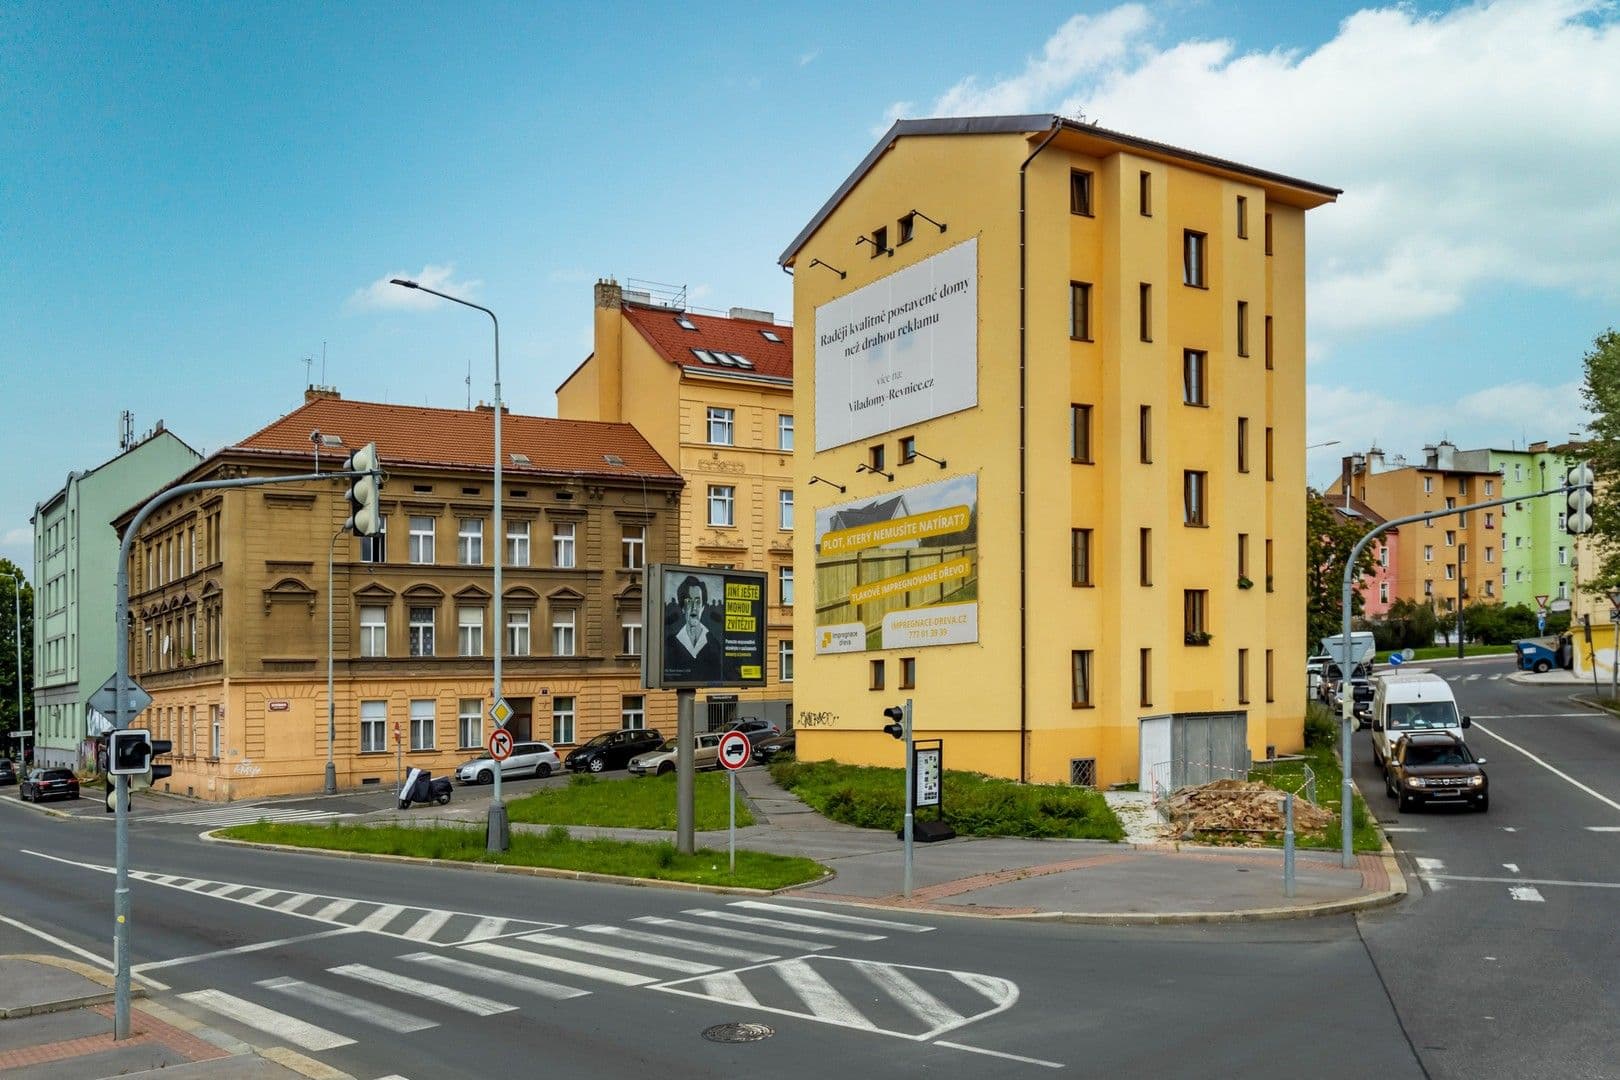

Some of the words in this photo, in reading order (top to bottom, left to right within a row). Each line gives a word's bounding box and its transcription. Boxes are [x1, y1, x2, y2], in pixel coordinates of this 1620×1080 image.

[820, 325, 848, 347] Raději
[849, 311, 887, 336] kvalitně
[887, 287, 938, 324] postavené
[939, 277, 970, 299] domy
[844, 341, 861, 357] než
[862, 330, 896, 351] drahou
[897, 311, 940, 337] reklamu
[848, 378, 935, 413] Viladomy-Revnice.cz
[823, 537, 845, 551] PLOT,
[847, 530, 872, 546] KTERÝ
[873, 522, 917, 540] NEMUSÍTE
[919, 513, 965, 531] NATÍRAT?
[881, 571, 937, 594] IMPREGNOVANÉ
[727, 601, 750, 614] MOHOU
